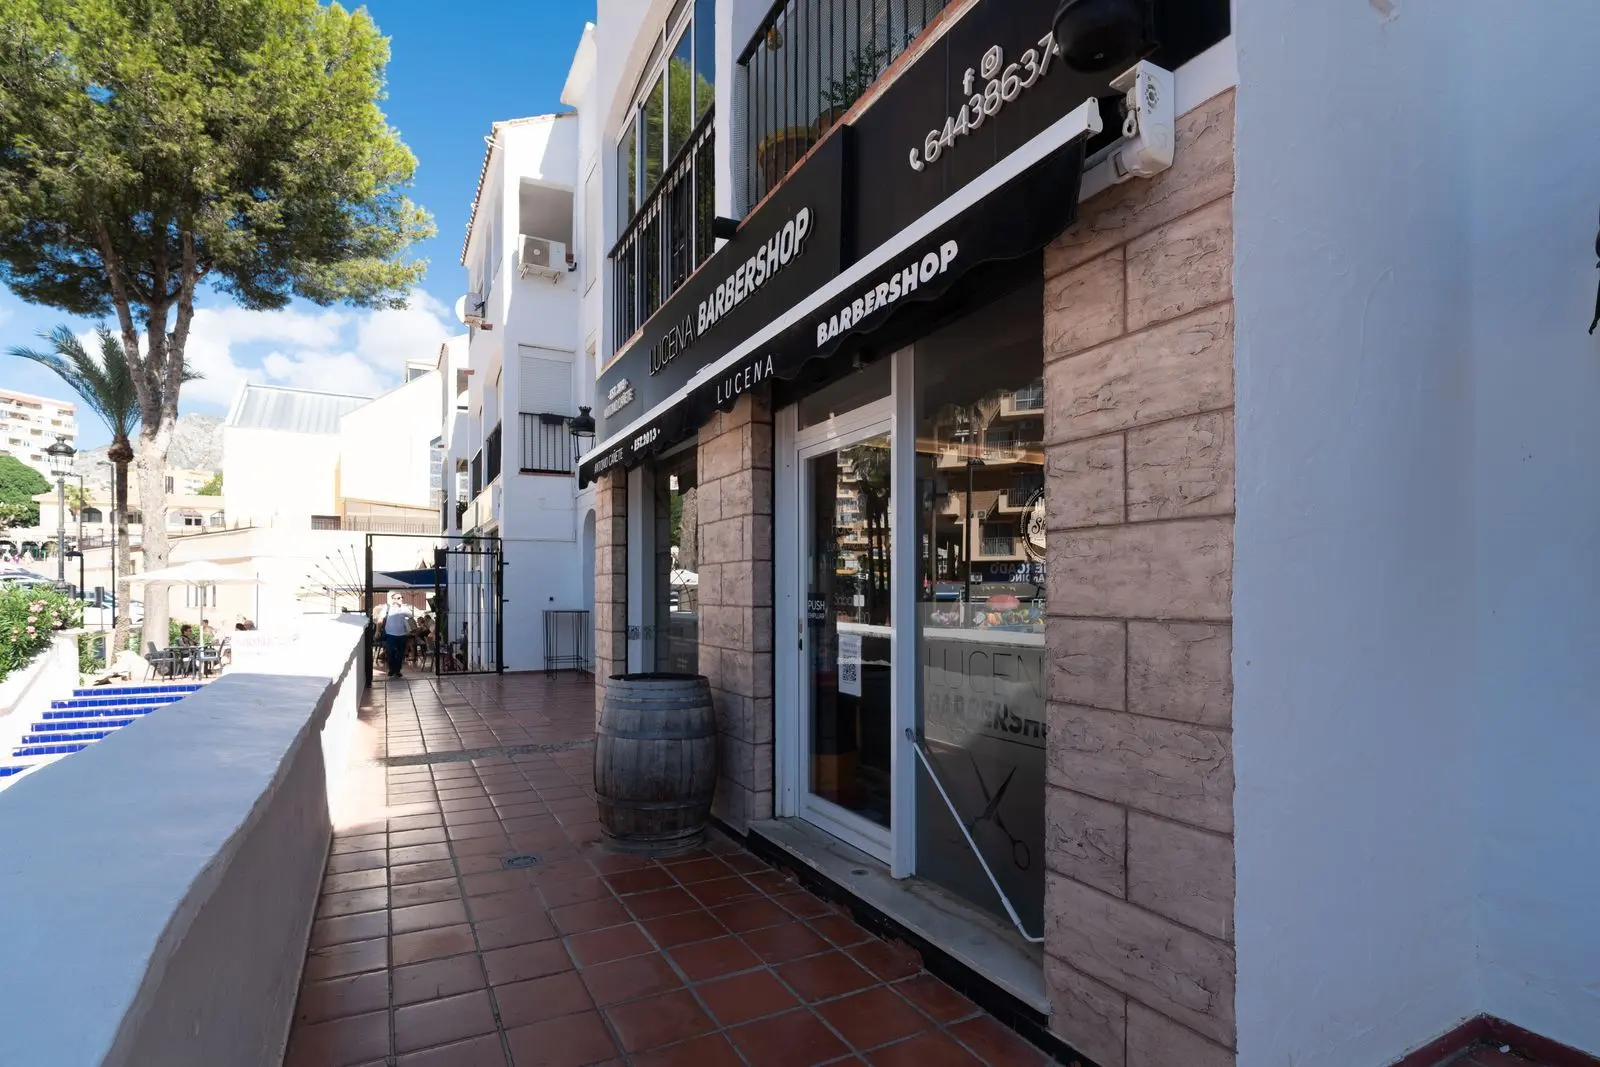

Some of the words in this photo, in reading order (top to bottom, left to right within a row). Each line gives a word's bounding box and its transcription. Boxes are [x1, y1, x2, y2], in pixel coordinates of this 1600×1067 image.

[649, 316, 697, 376] LUCENA
[697, 206, 814, 336] BARBERSHOP
[816, 239, 959, 348] BARBERSHOP
[716, 354, 774, 404] LUCENA
[808, 600, 825, 611] PUSH
